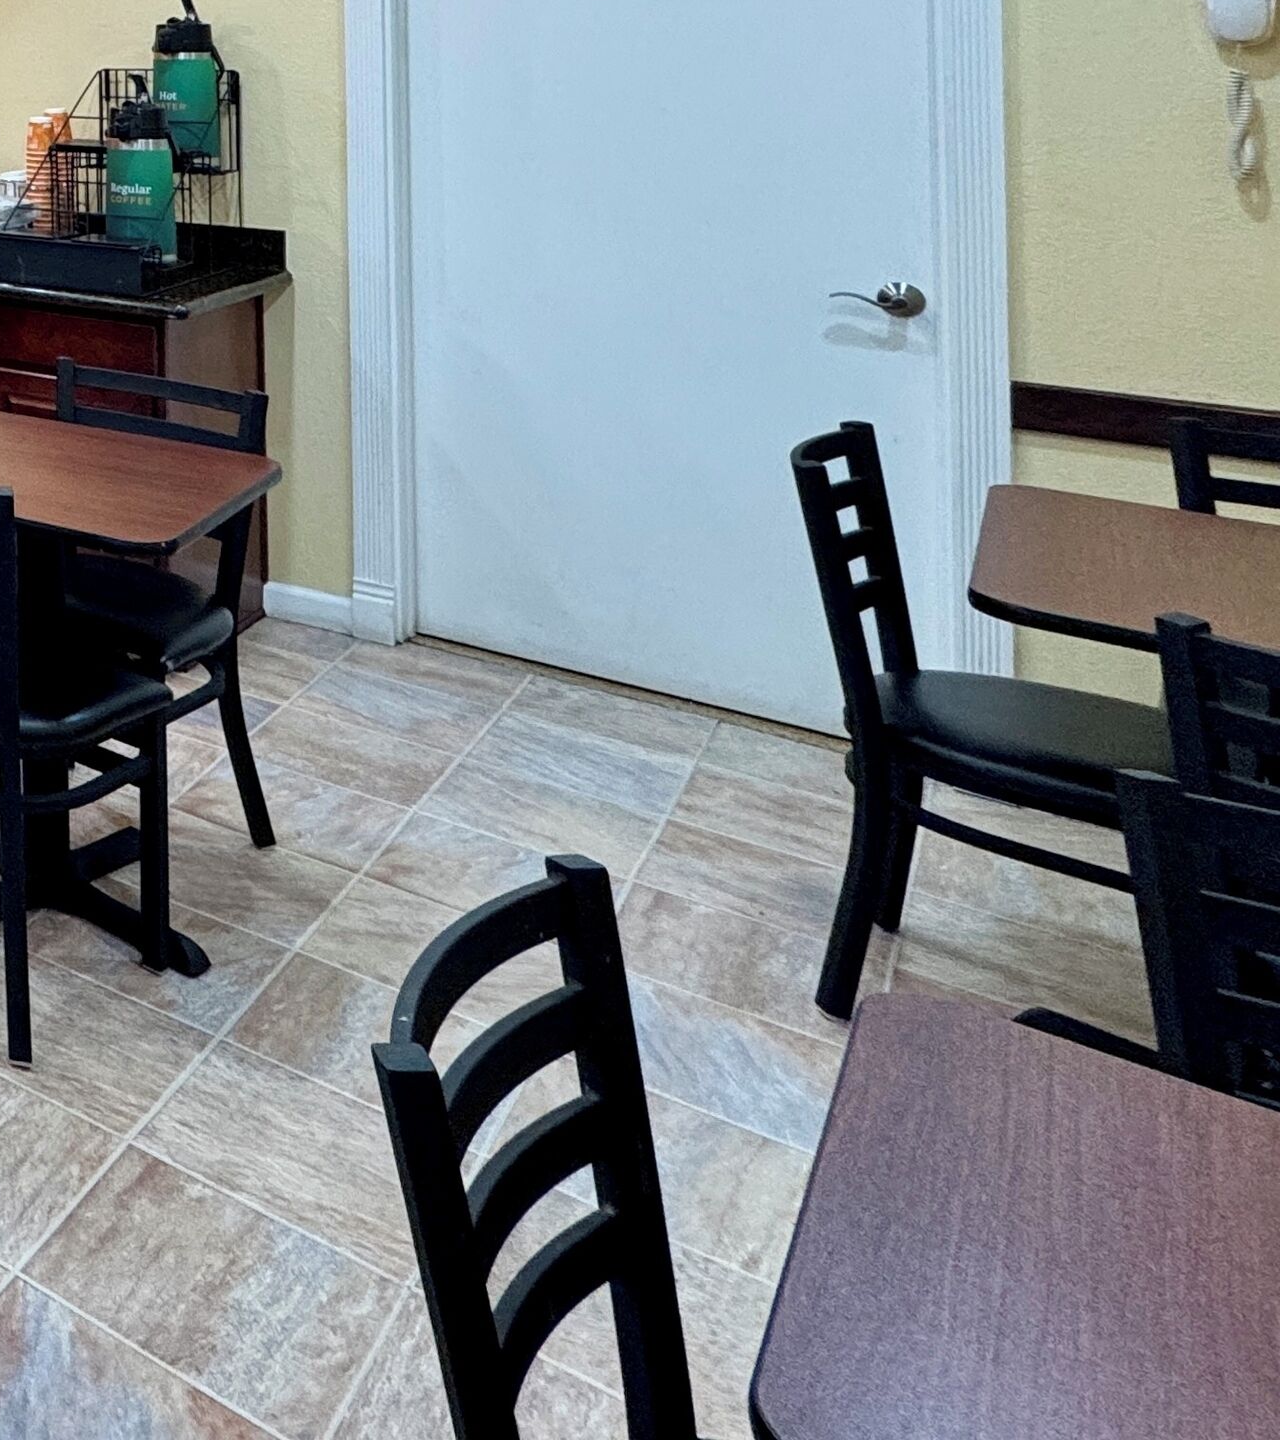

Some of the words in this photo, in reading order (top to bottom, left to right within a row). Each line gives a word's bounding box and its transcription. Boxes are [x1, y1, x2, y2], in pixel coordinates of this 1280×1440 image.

[159, 90, 177, 101] Hot
[153, 102, 187, 112] ATER
[110, 182, 152, 195] Regular
[110, 195, 152, 206] COFFEE
